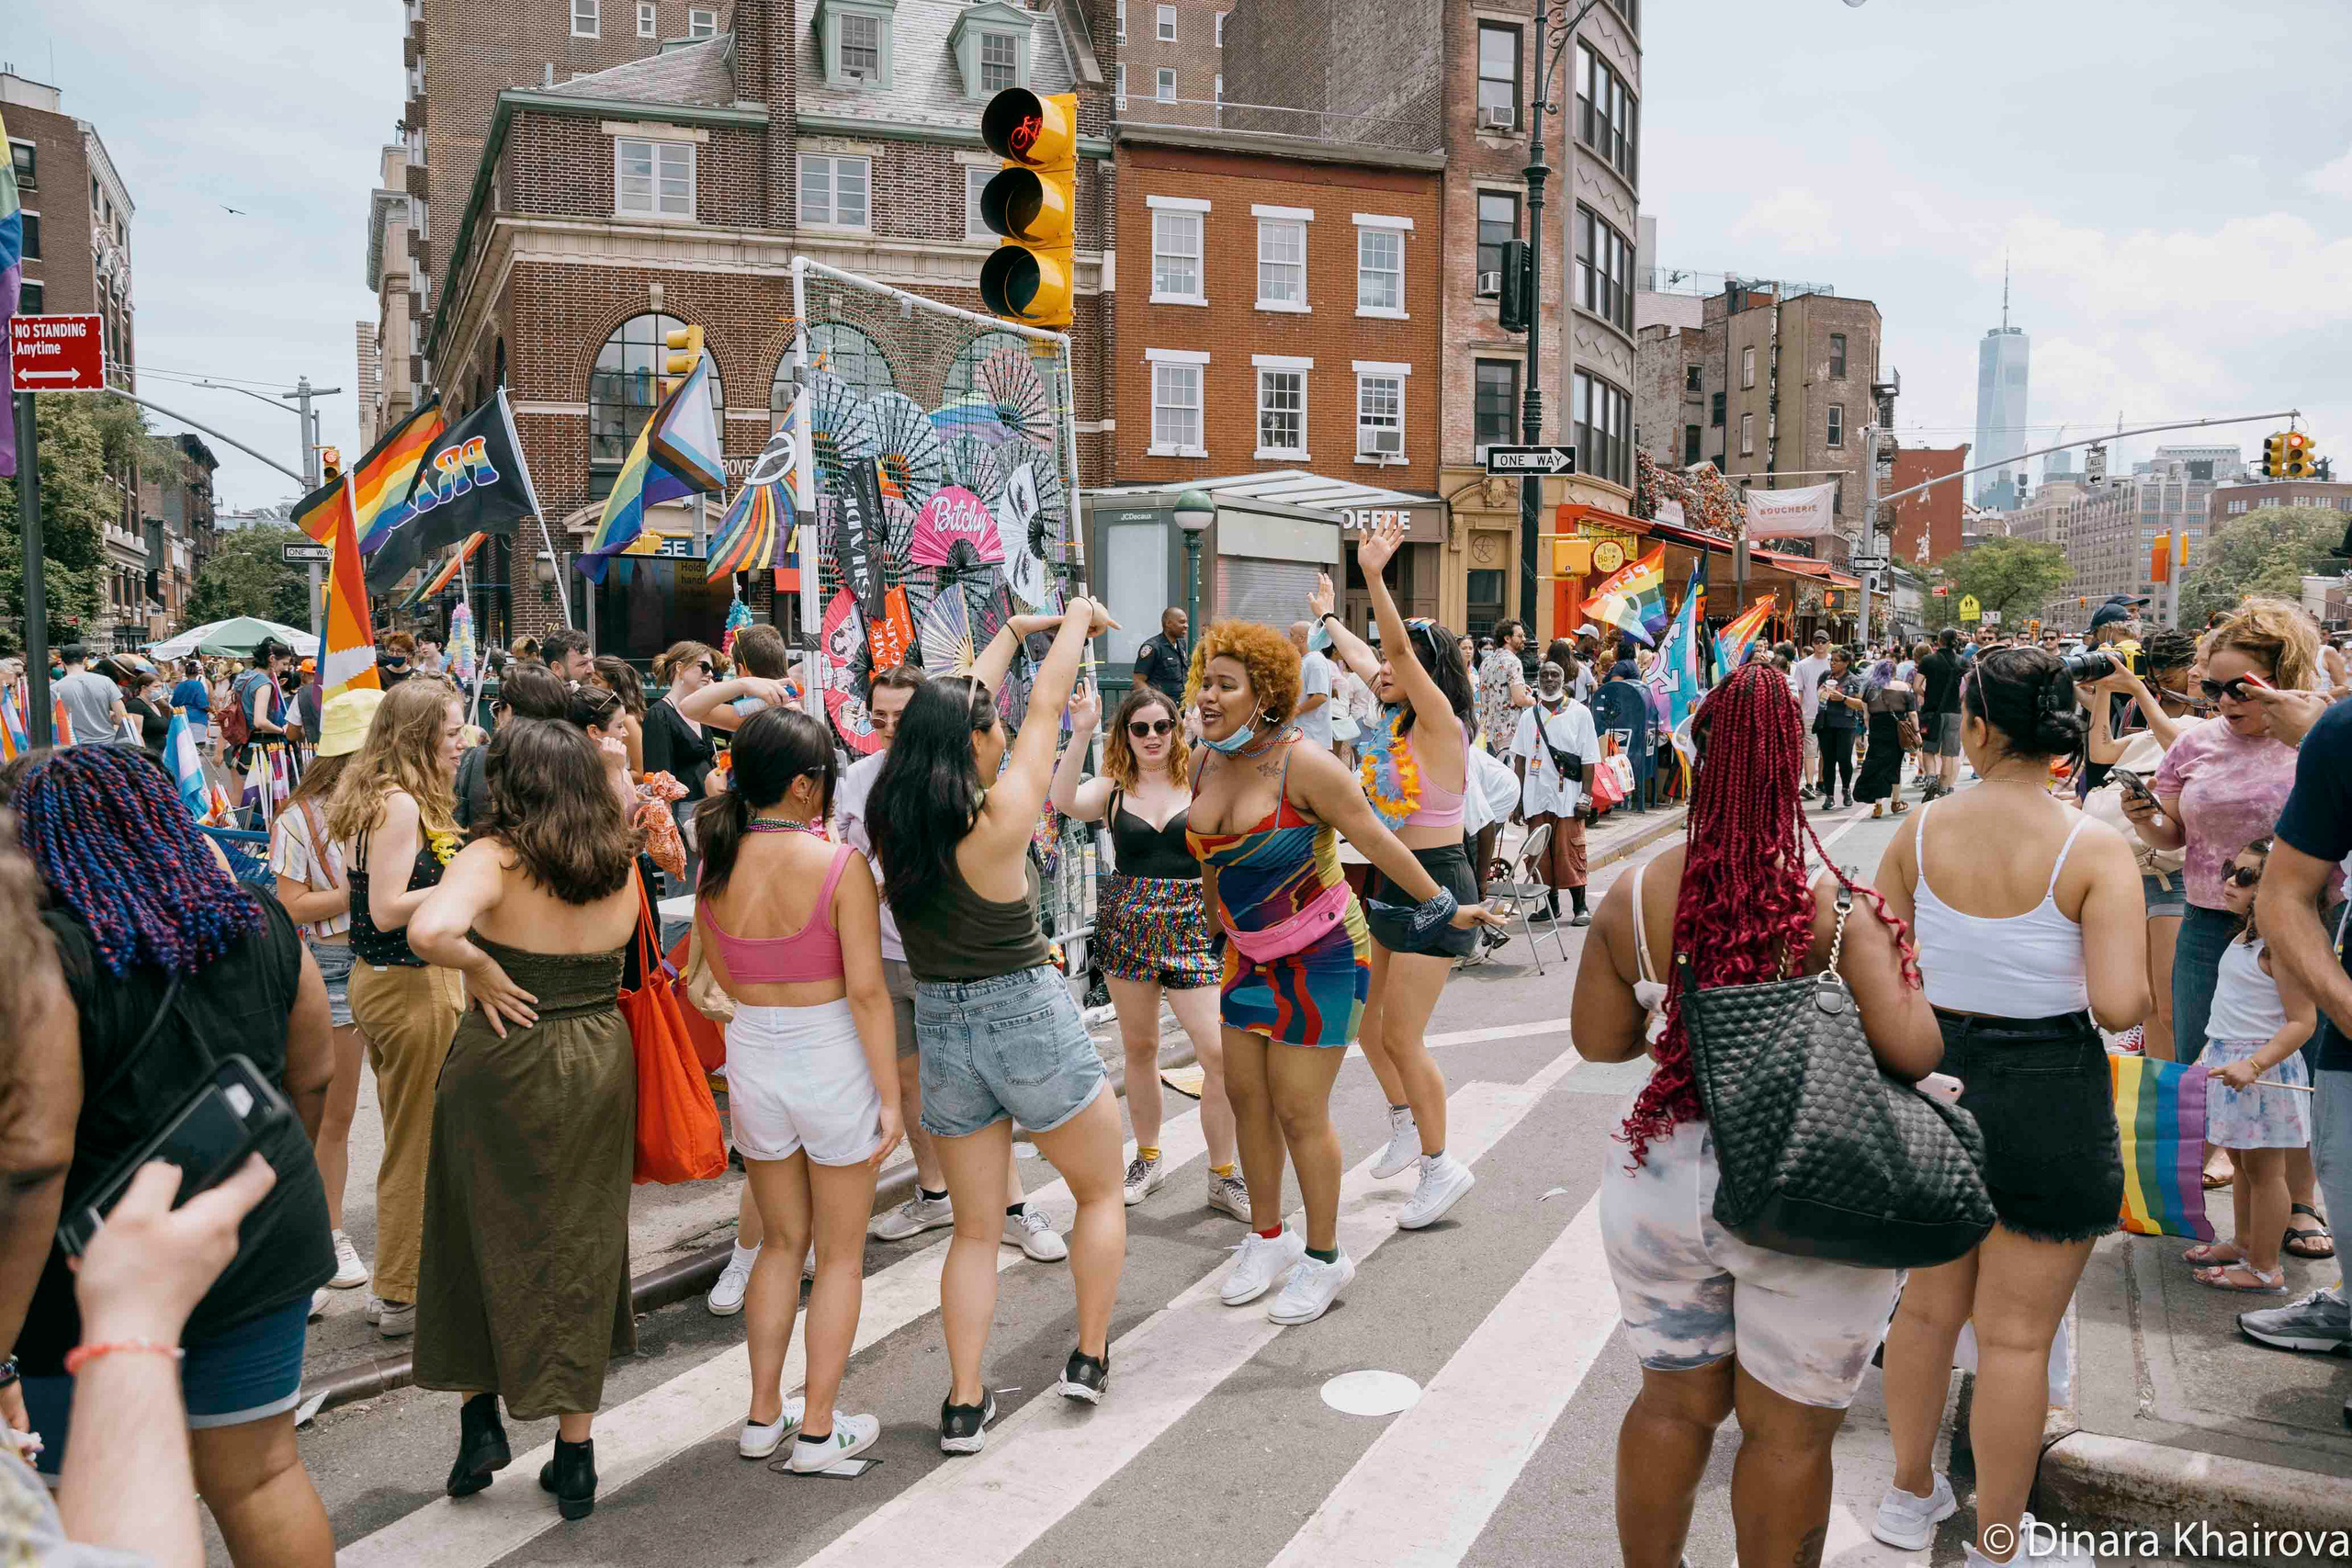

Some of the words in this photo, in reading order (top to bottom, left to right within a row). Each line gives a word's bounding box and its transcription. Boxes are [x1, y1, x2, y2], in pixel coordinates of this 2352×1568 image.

[15, 324, 30, 338] NO
[33, 323, 86, 338] STANDING
[17, 341, 62, 358] Anytime
[721, 459, 753, 476] ROVE
[1499, 455, 1525, 466] ONE
[1536, 455, 1563, 466] WAY
[1121, 513, 1152, 521] JCDecaux
[1760, 504, 1818, 515] BOUCHERIE
[931, 496, 987, 542] Bitchy
[1341, 509, 1411, 530] OFFEE
[546, 622, 560, 633] 74
[886, 617, 900, 665] GAIN
